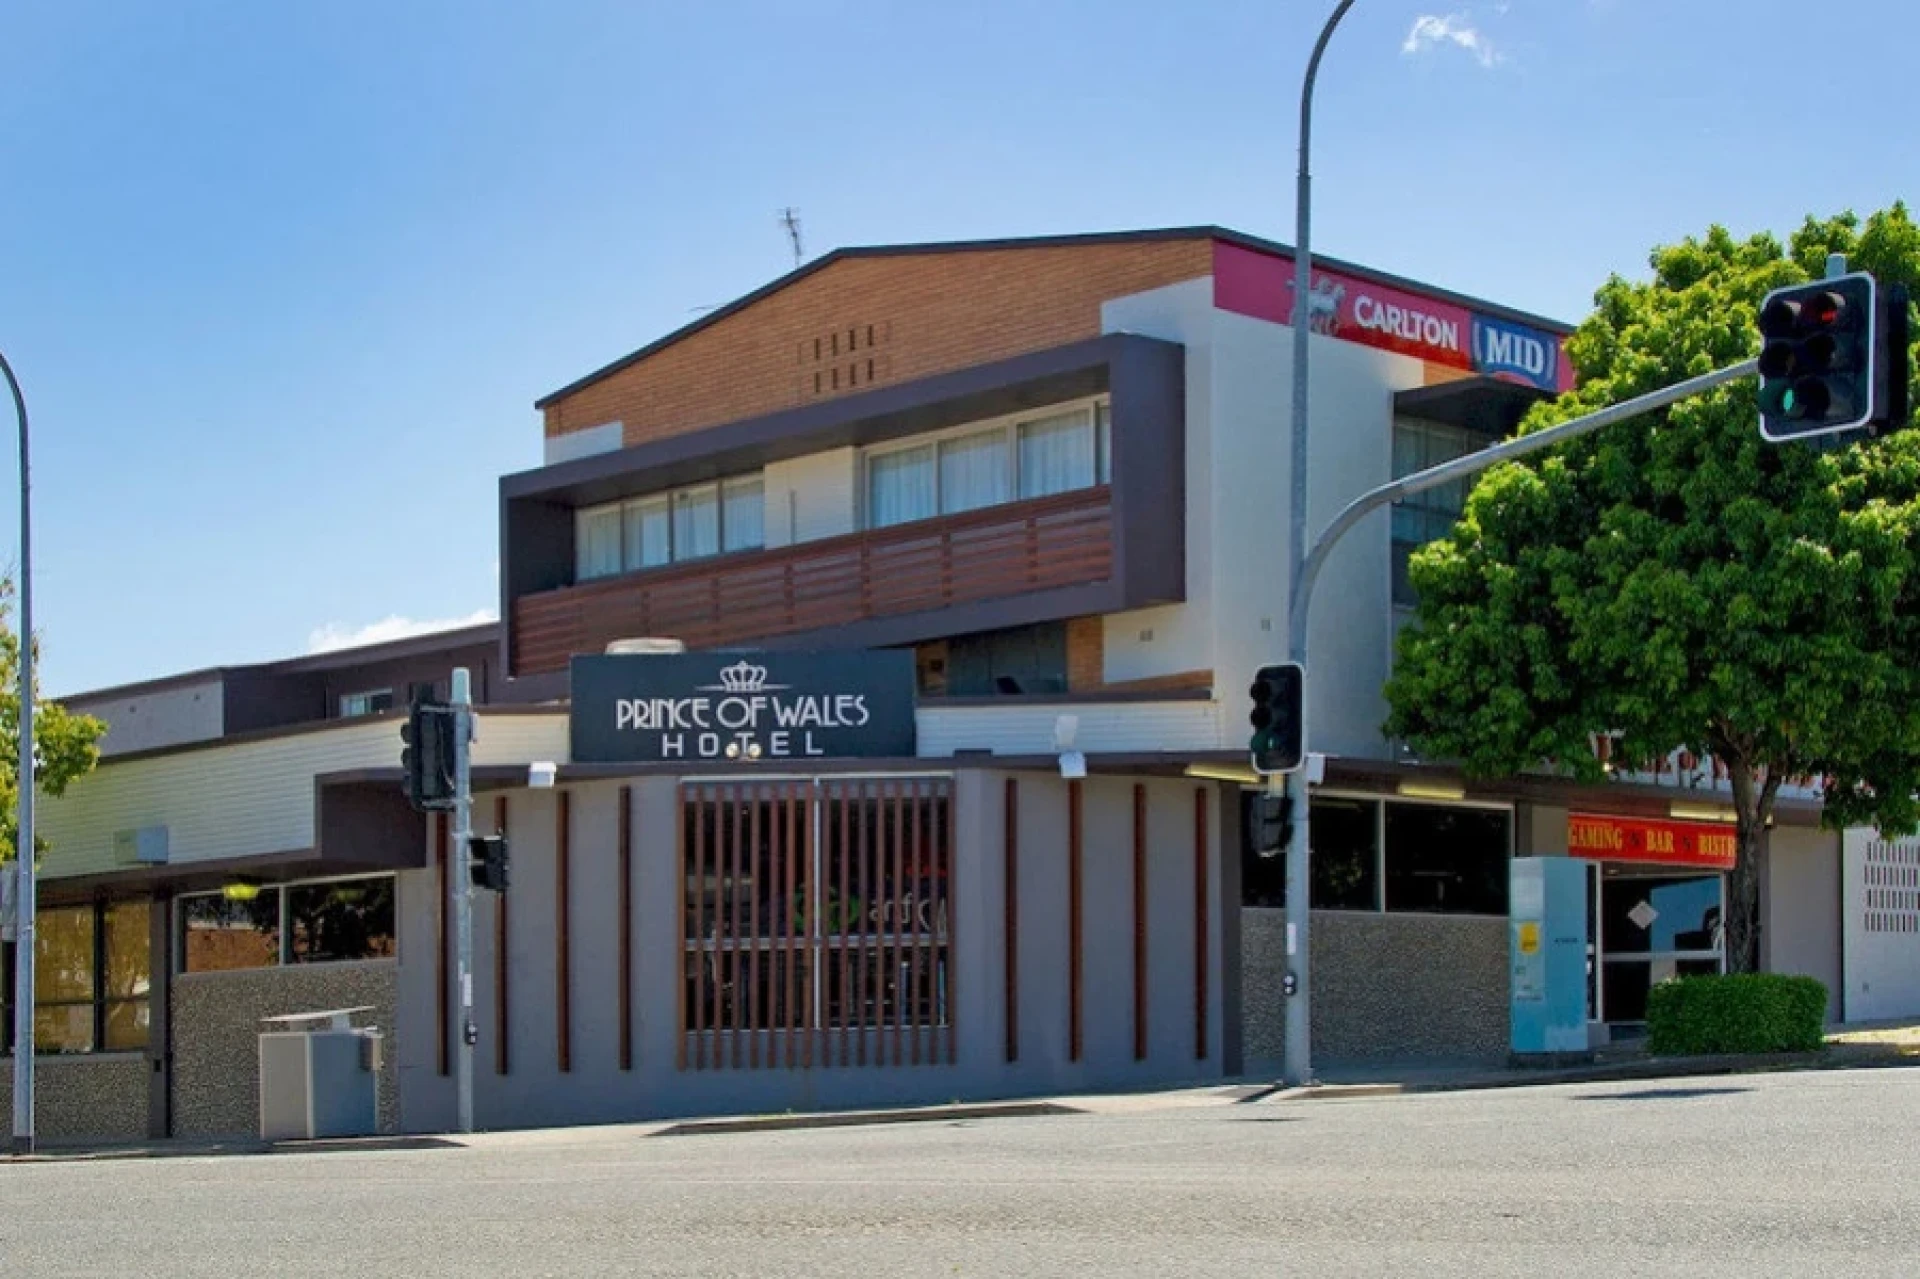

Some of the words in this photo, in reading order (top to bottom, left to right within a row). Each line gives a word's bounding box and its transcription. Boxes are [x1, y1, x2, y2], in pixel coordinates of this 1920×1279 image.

[1354, 296, 1458, 351] CARLTON
[1486, 329, 1543, 375] MID
[616, 698, 710, 729] PRINCE
[716, 697, 768, 727] OF
[772, 695, 869, 727] WALES
[662, 732, 823, 757] HOTEL
[1646, 830, 1674, 853] BAR
